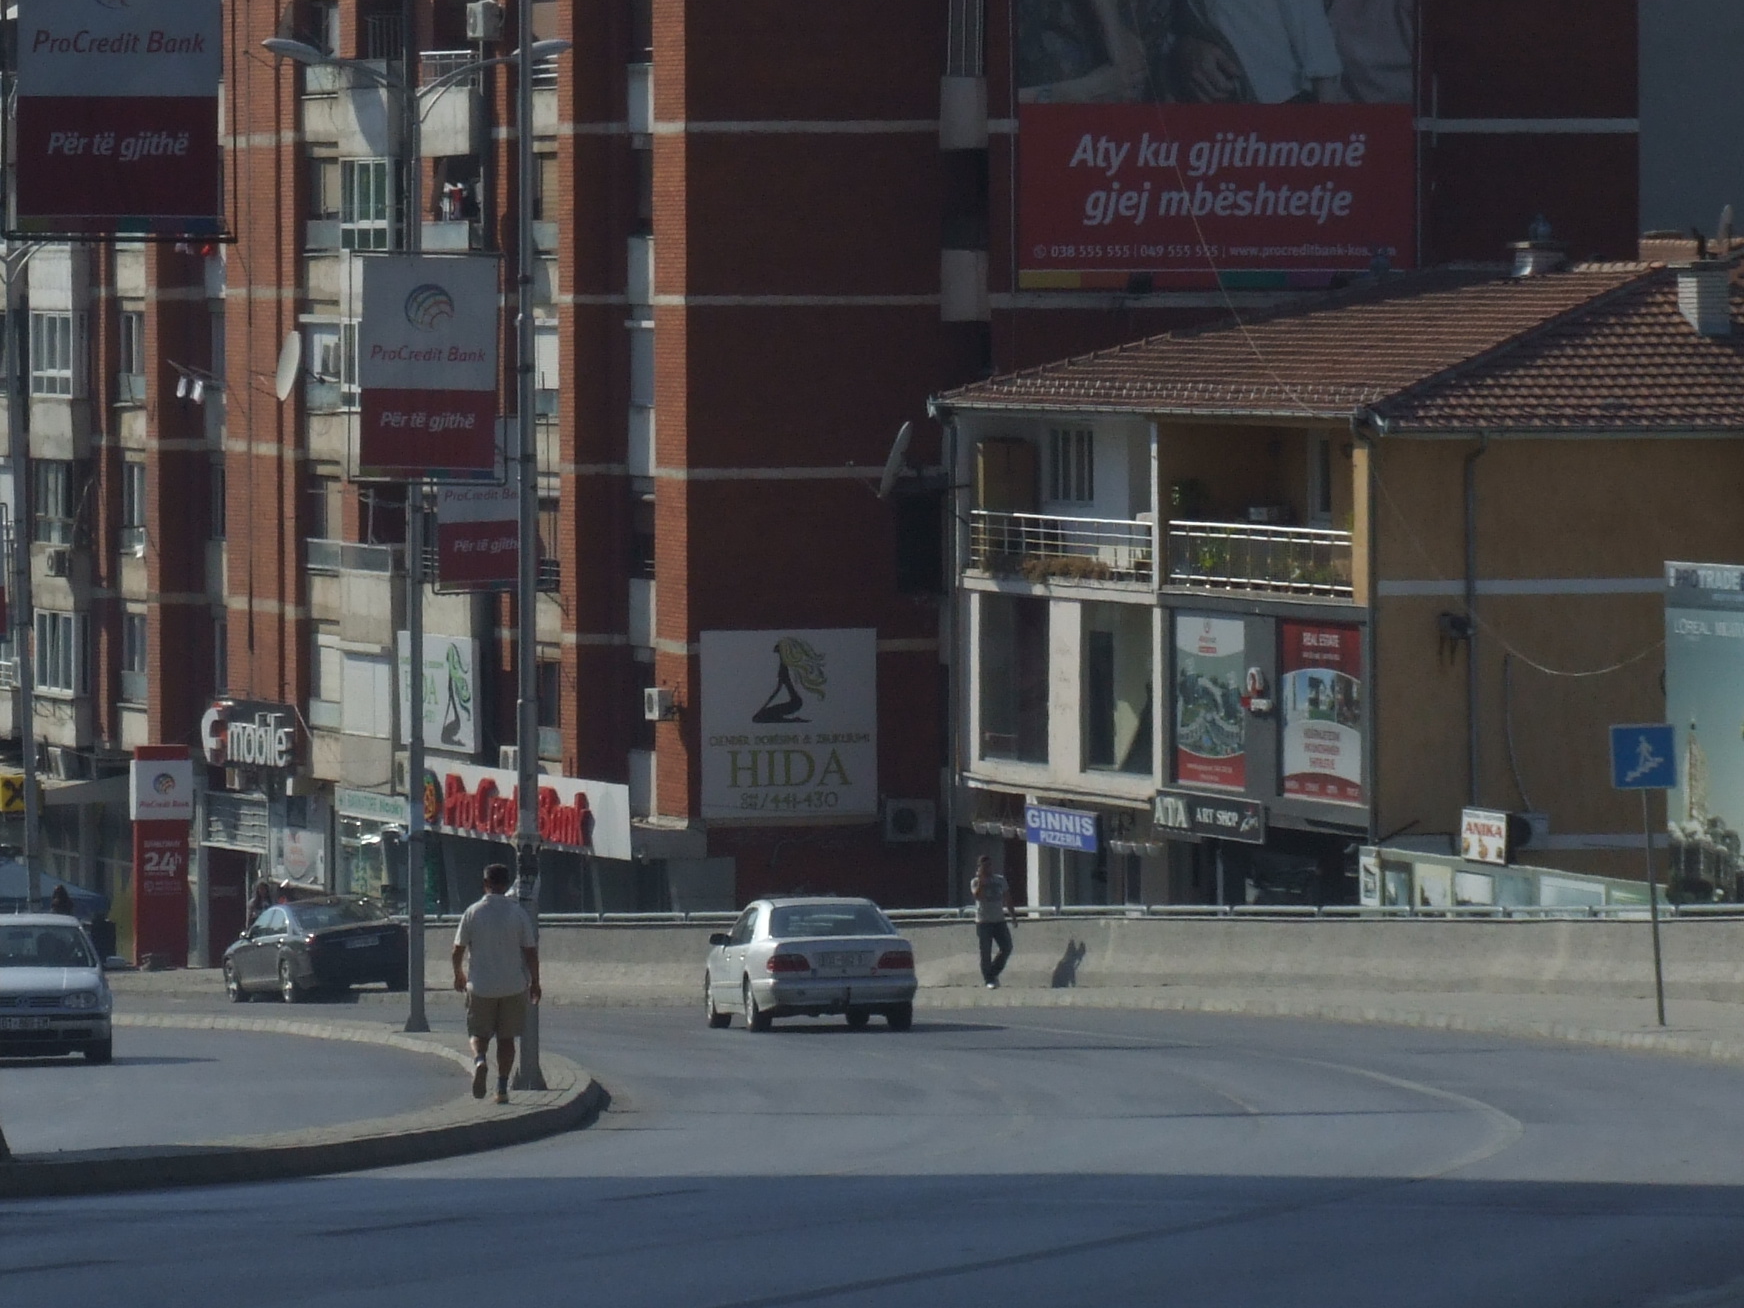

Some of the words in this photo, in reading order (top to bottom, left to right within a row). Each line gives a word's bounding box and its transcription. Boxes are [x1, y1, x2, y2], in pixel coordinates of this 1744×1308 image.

[32, 30, 141, 54] ProCredit
[146, 30, 206, 54] Bank
[47, 131, 90, 155] Për
[92, 131, 116, 155] të
[119, 131, 190, 162] gjithë
[1068, 133, 1131, 177] Aty
[1136, 133, 1181, 167] ku
[1186, 133, 1369, 178] gjithmonë
[1082, 182, 1153, 226] gjej
[1158, 182, 1355, 225] mbështetje
[1050, 243, 1076, 259] 038
[1078, 243, 1104, 259] 555
[1106, 243, 1131, 259] 555
[1167, 243, 1192, 259] 555
[370, 344, 443, 362] ProCredit
[447, 346, 486, 363] Bank
[227, 711, 293, 767] mobile
[727, 747, 854, 790] HIDA
[443, 772, 518, 839] ProCred
[1154, 795, 1192, 829] ATA
[1196, 806, 1214, 823] ART
[1215, 810, 1239, 827] SHOP
[1026, 809, 1094, 836] GINNIS
[1465, 821, 1503, 838] ANIKA
[1039, 830, 1082, 847] PIZZERIA
[143, 851, 183, 878] 24h
